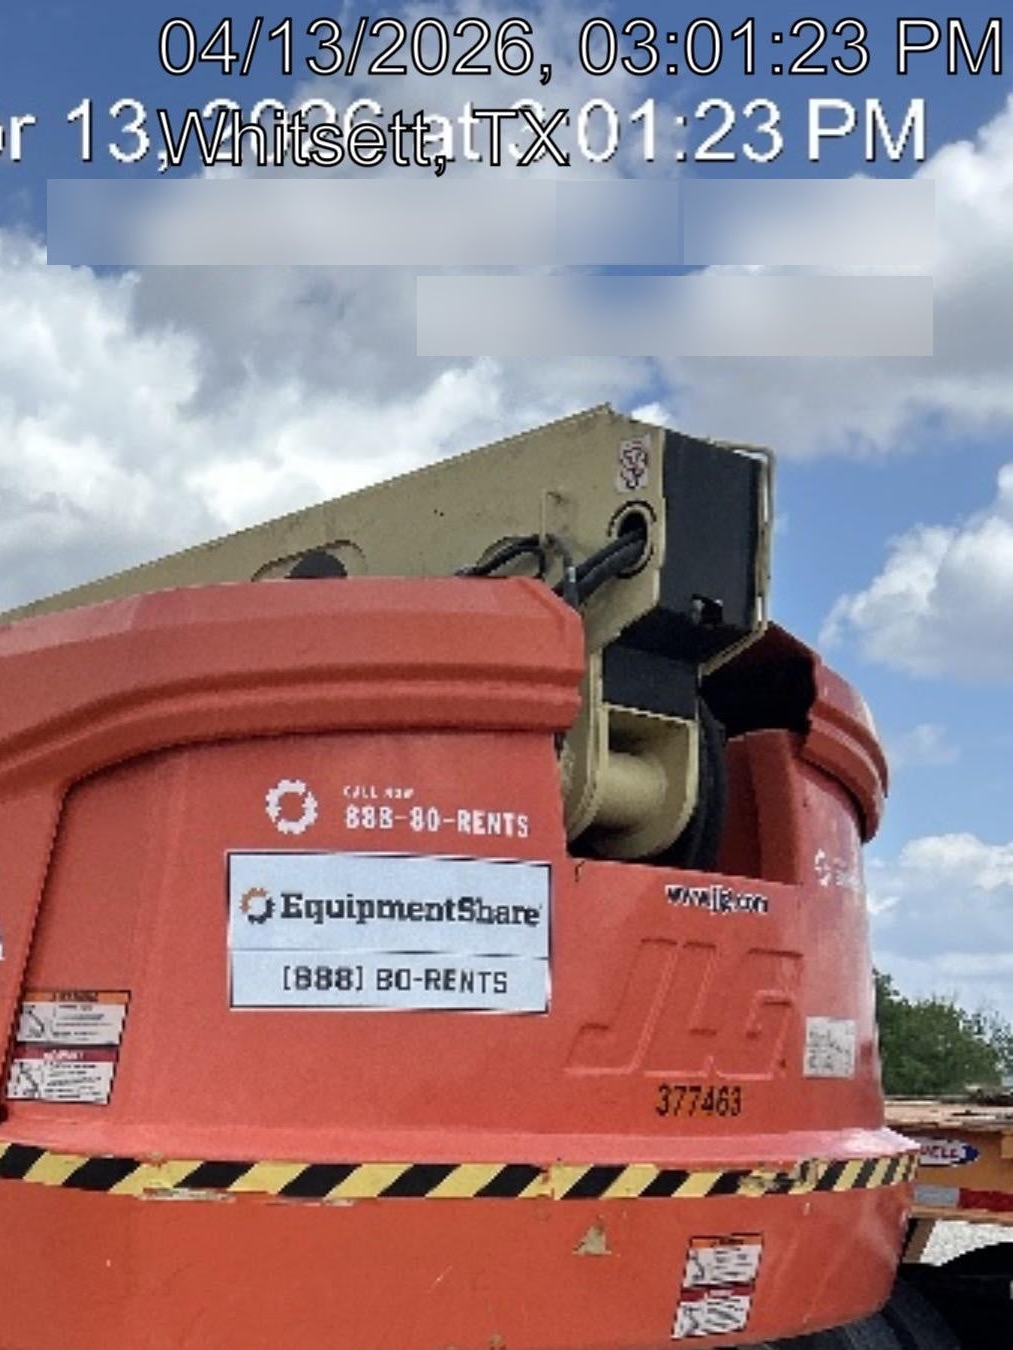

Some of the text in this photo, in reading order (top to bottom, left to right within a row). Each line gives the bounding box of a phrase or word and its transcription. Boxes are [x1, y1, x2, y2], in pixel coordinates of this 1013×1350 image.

[344, 803, 530, 838] 888-80-RENTS
[280, 893, 540, 927] EquipmentShare
[656, 1085, 742, 1117] 377463
